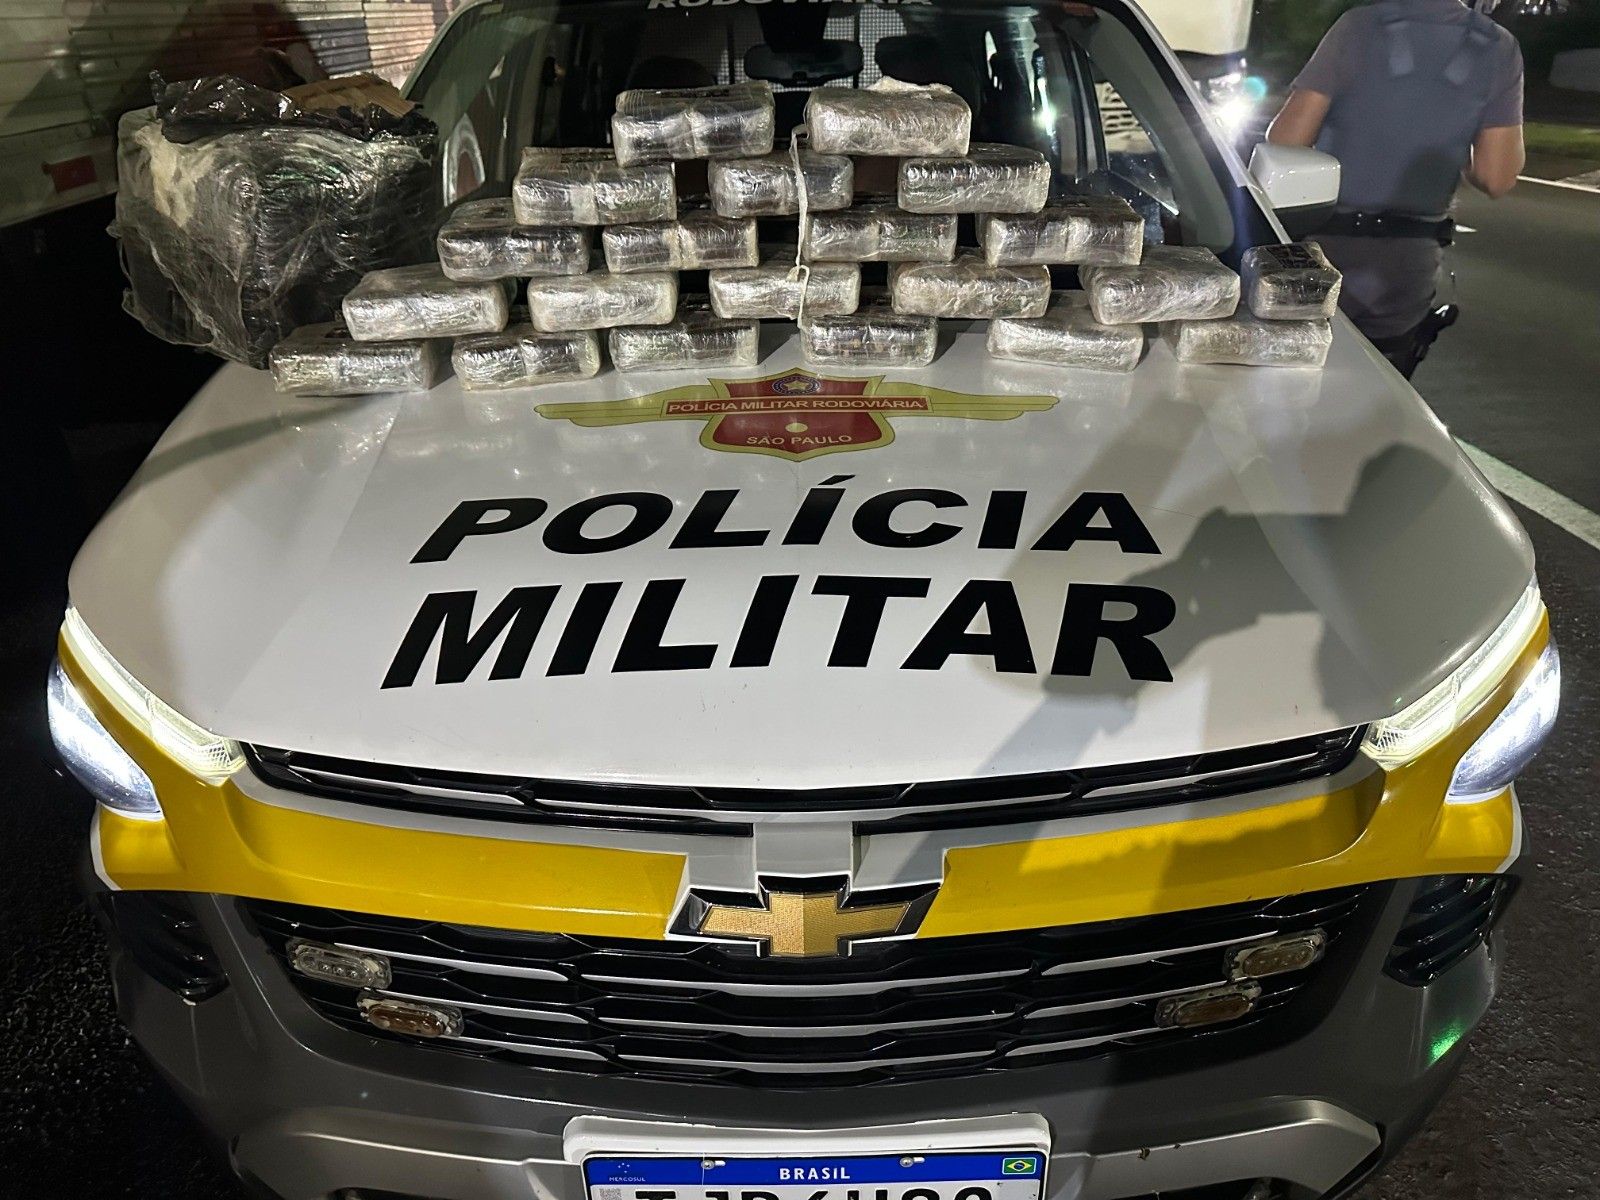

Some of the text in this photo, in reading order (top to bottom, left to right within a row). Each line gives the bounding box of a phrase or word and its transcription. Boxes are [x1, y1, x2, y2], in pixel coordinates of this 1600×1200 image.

[668, 398, 923, 413] POLÍCIA MILITAR RODOVIÁRIA
[791, 435, 852, 445] PAULO
[410, 474, 1162, 564] POLÍCIA
[380, 575, 1176, 690] MILITAR
[779, 1166, 851, 1181] BRASIL
